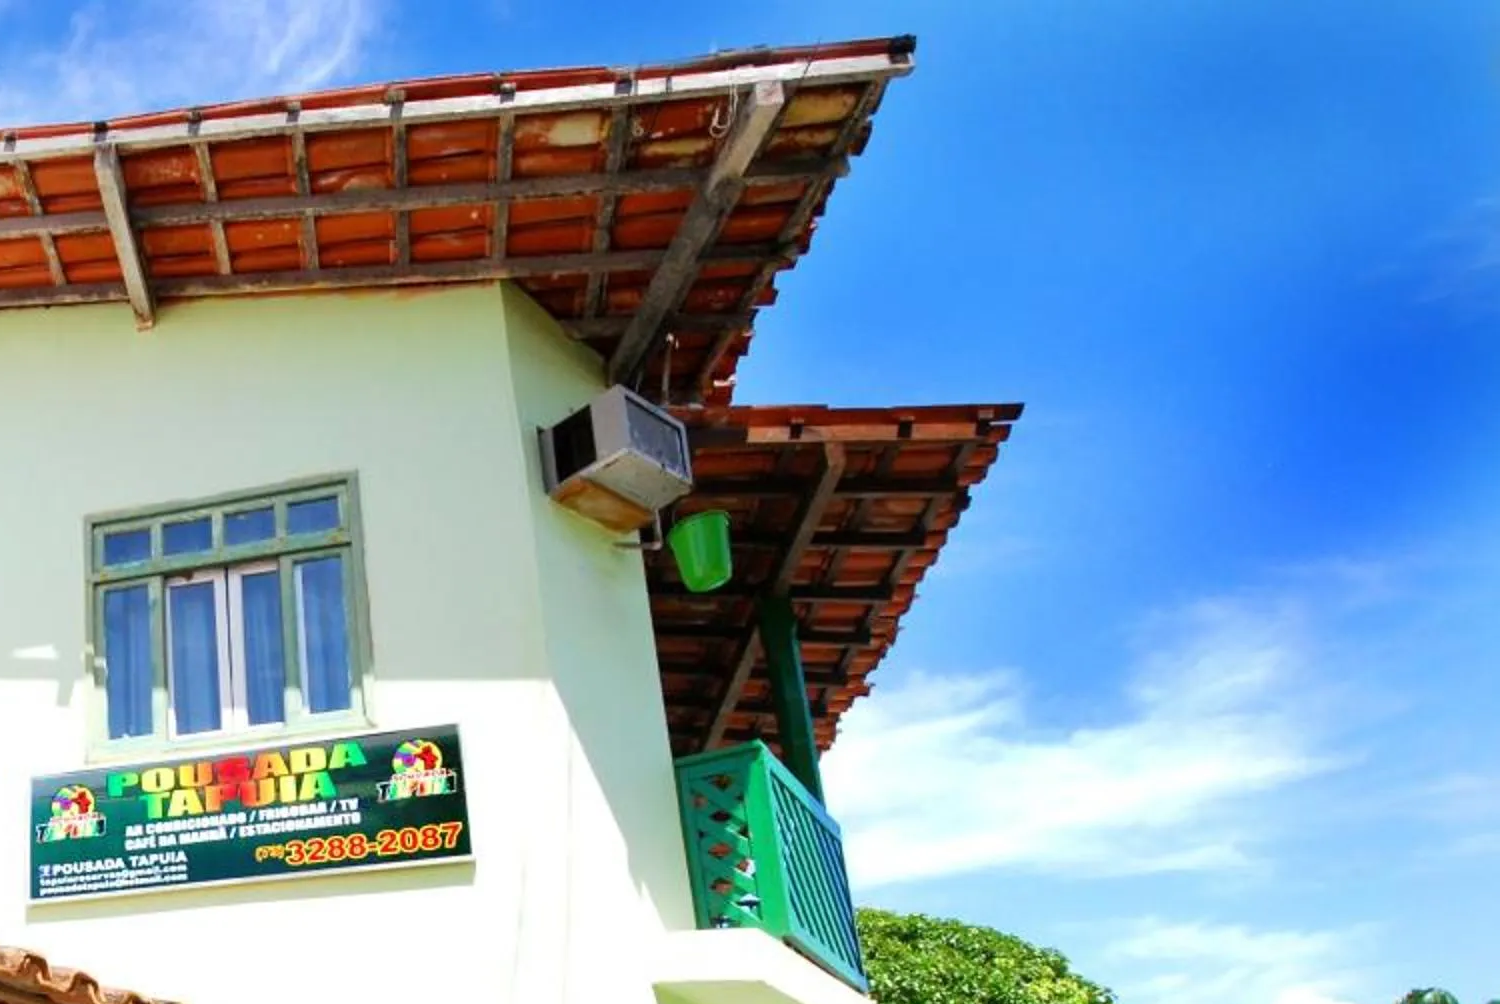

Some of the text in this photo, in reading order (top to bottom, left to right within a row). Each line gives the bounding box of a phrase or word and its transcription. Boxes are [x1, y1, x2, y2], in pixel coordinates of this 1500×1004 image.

[106, 741, 367, 797] POUSADA
[141, 771, 337, 819] TAPUIA
[340, 798, 358, 811] TV
[239, 812, 361, 838] ESTACIONAMENTO
[285, 821, 463, 866] 3288-2087
[52, 850, 188, 876] POUSADA TAPUIA
